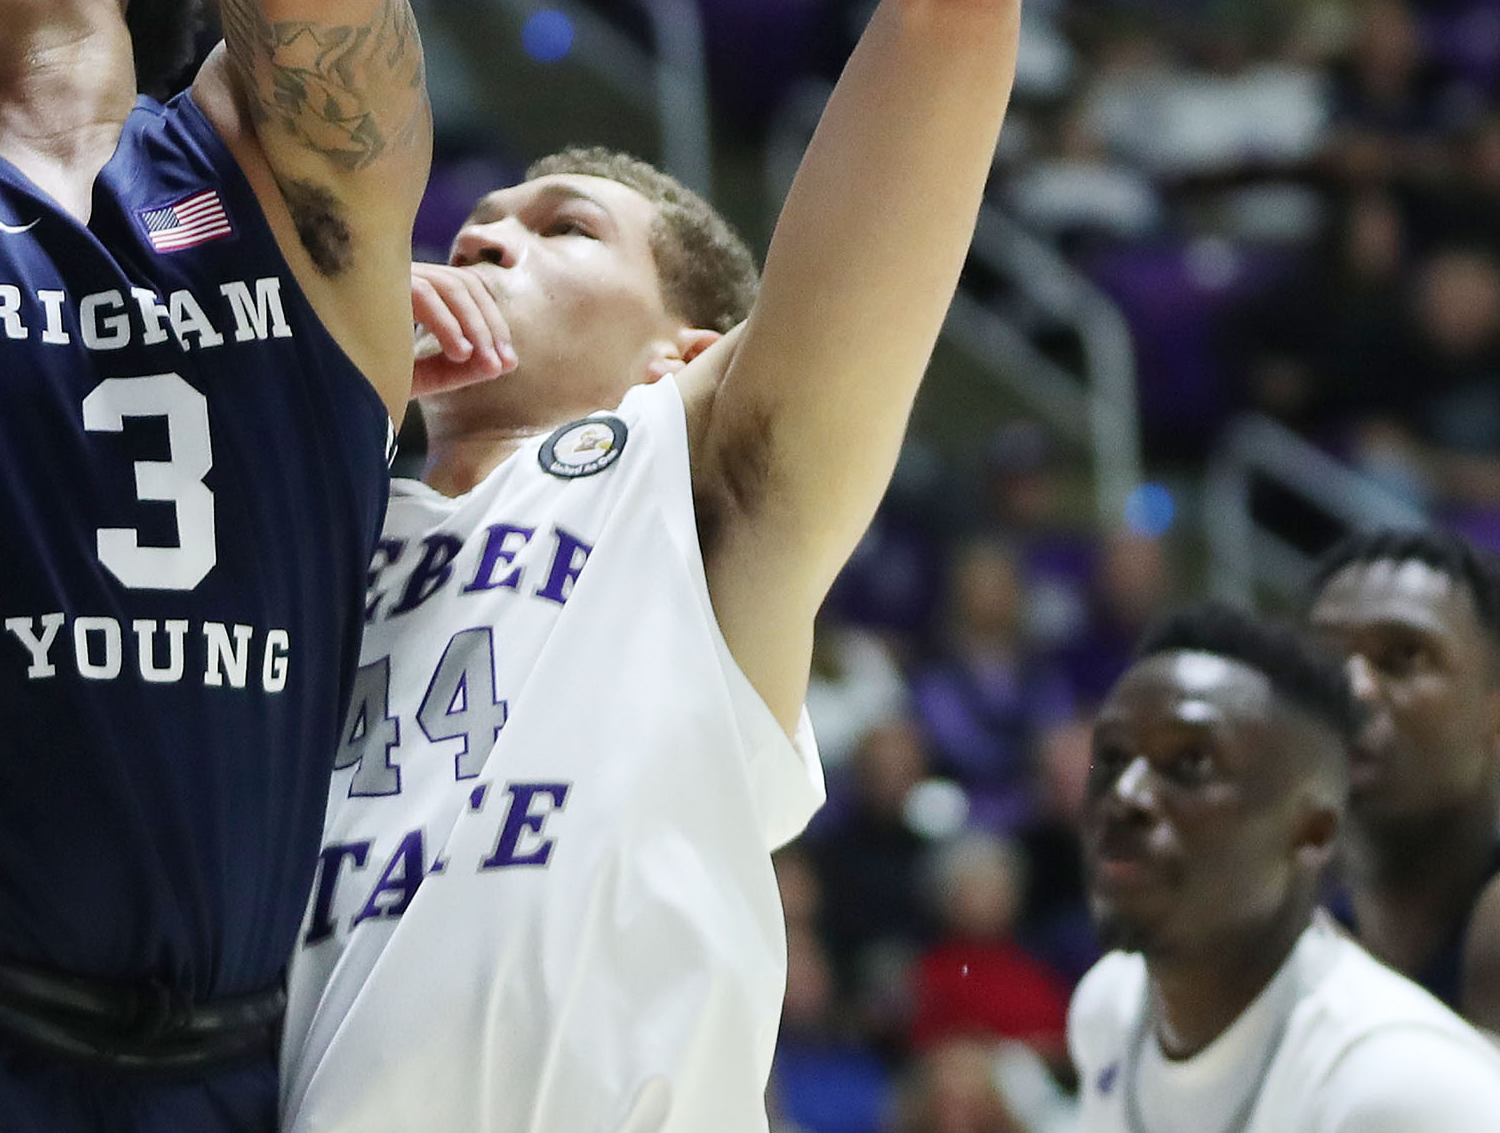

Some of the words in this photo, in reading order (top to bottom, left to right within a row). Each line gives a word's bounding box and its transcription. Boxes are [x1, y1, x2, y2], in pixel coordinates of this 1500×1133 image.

[82, 372, 217, 591] 3
[4, 613, 291, 694] YOUNG
[364, 521, 594, 623] EBER
[333, 626, 508, 798] 44
[302, 779, 573, 948] TAE
